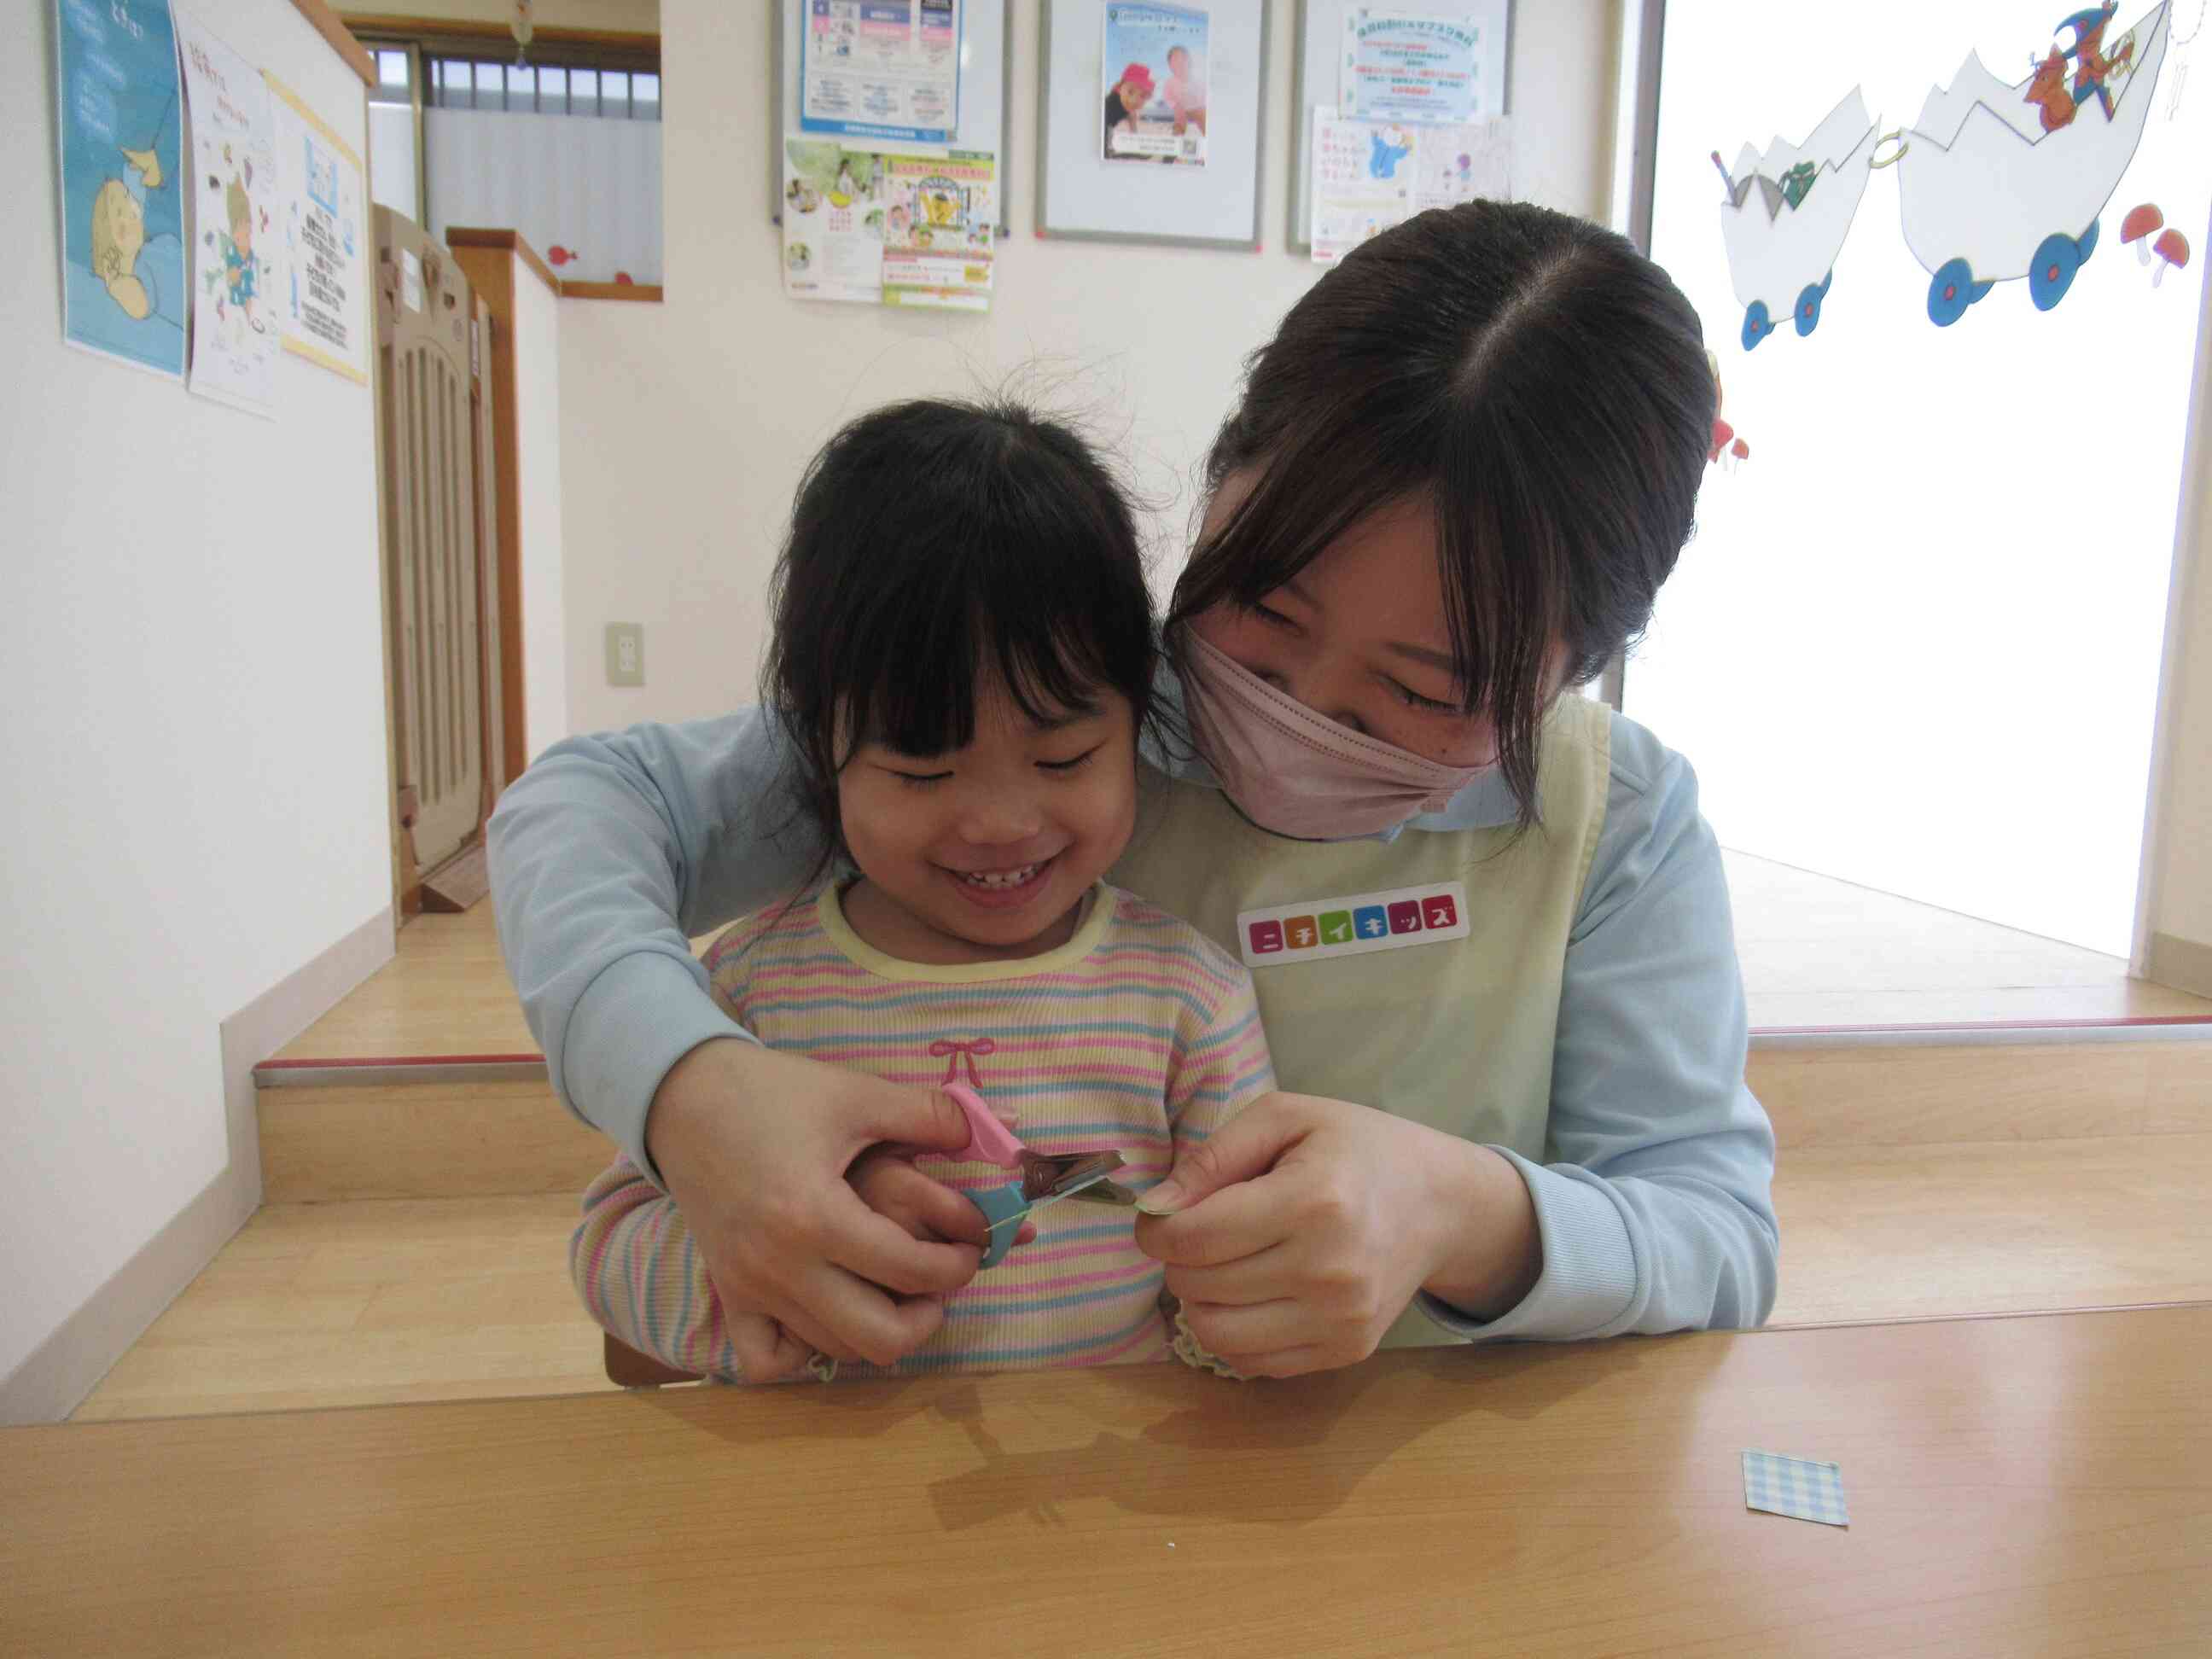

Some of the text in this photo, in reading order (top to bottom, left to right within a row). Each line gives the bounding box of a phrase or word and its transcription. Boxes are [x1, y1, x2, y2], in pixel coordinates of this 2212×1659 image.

[1261, 905, 1453, 950] ニチイキッズ
